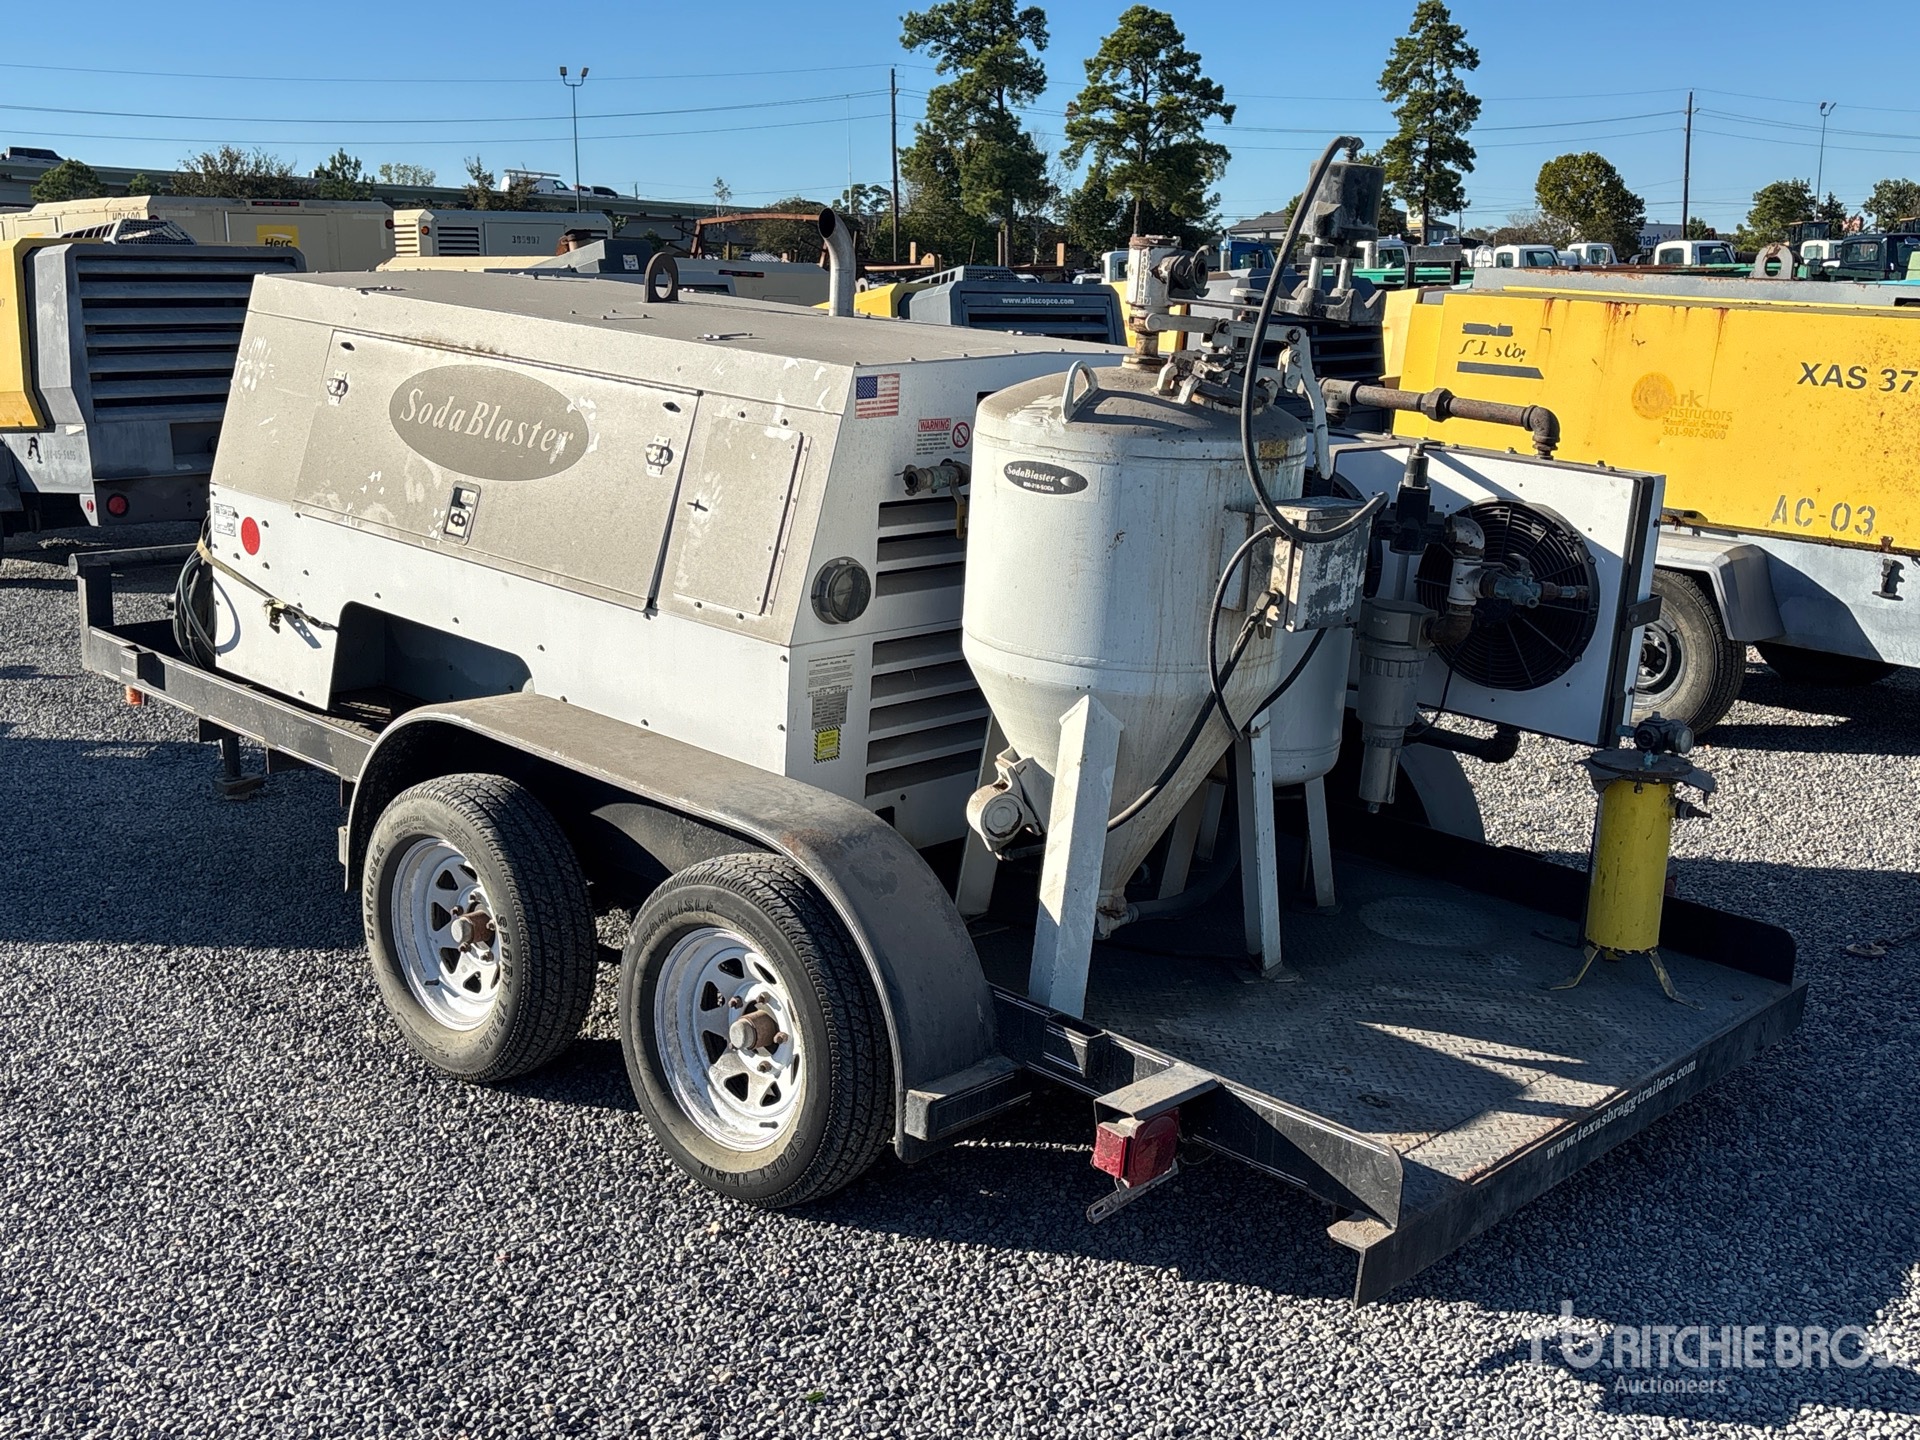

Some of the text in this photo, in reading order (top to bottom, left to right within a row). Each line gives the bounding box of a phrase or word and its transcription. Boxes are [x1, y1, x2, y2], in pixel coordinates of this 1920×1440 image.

[1001, 296, 1075, 306] www.atlascopco.com
[1796, 362, 1920, 393] XAS 37
[399, 388, 575, 457] SodaBlaster
[919, 420, 950, 431] WARNING
[1006, 465, 1056, 482] SodaBlaster
[1771, 494, 1876, 536] AC-03
[365, 845, 385, 942] CARLISLE
[641, 899, 716, 947] CARLISLE
[496, 913, 513, 994] SPORT
[1546, 1059, 1697, 1160] www.texasbraggtrailers.com
[757, 1130, 806, 1186] SPORT
